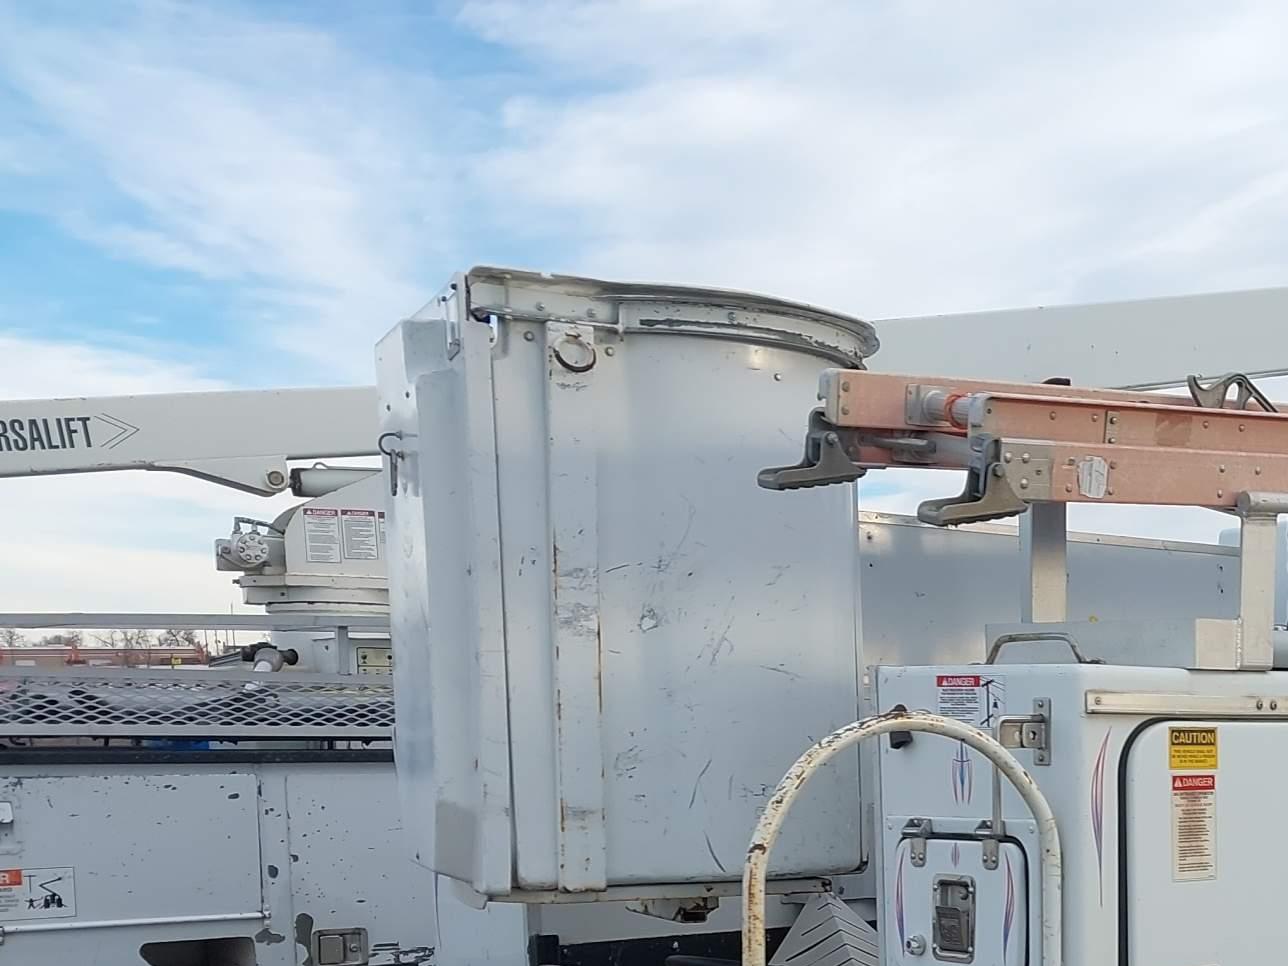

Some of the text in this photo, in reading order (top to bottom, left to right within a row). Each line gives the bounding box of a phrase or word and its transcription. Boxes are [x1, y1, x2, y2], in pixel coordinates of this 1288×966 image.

[948, 677, 975, 686] DANGER
[1172, 731, 1215, 744] CAUTION
[1182, 777, 1213, 787] DANGER
